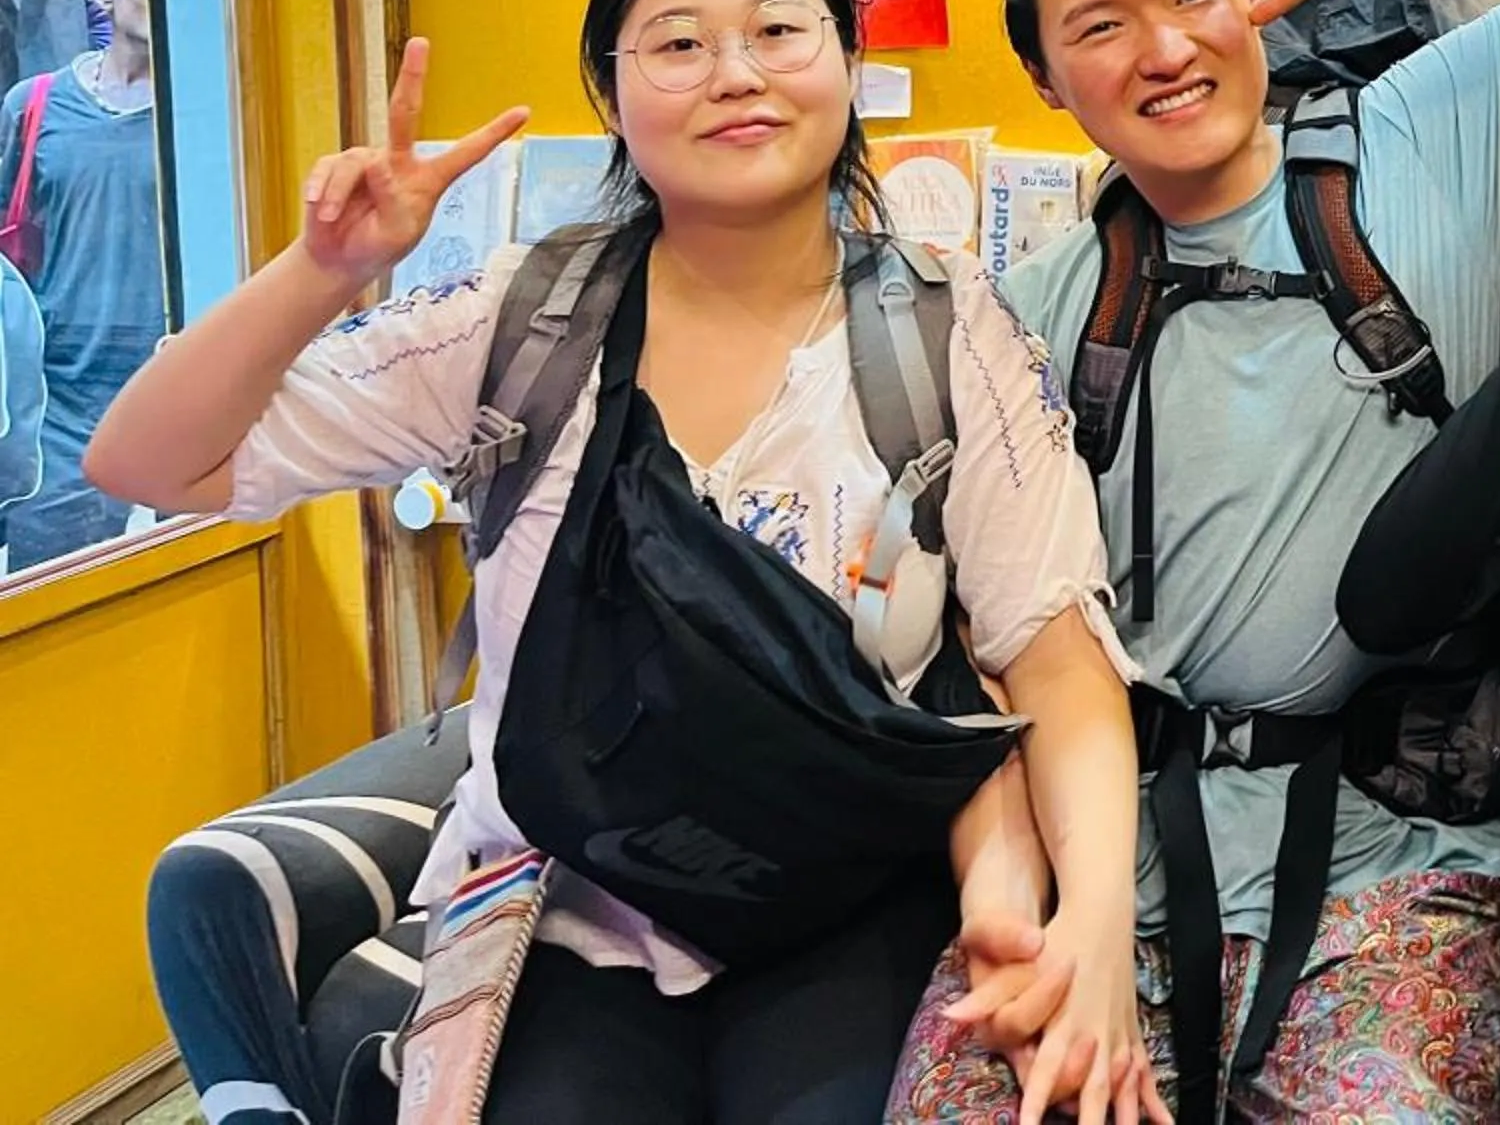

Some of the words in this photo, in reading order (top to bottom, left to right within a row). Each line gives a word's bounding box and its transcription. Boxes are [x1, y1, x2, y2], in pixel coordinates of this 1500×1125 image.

[1021, 176, 1036, 186] DU
[989, 187, 1010, 281] outard
[629, 815, 781, 883] NIKE
